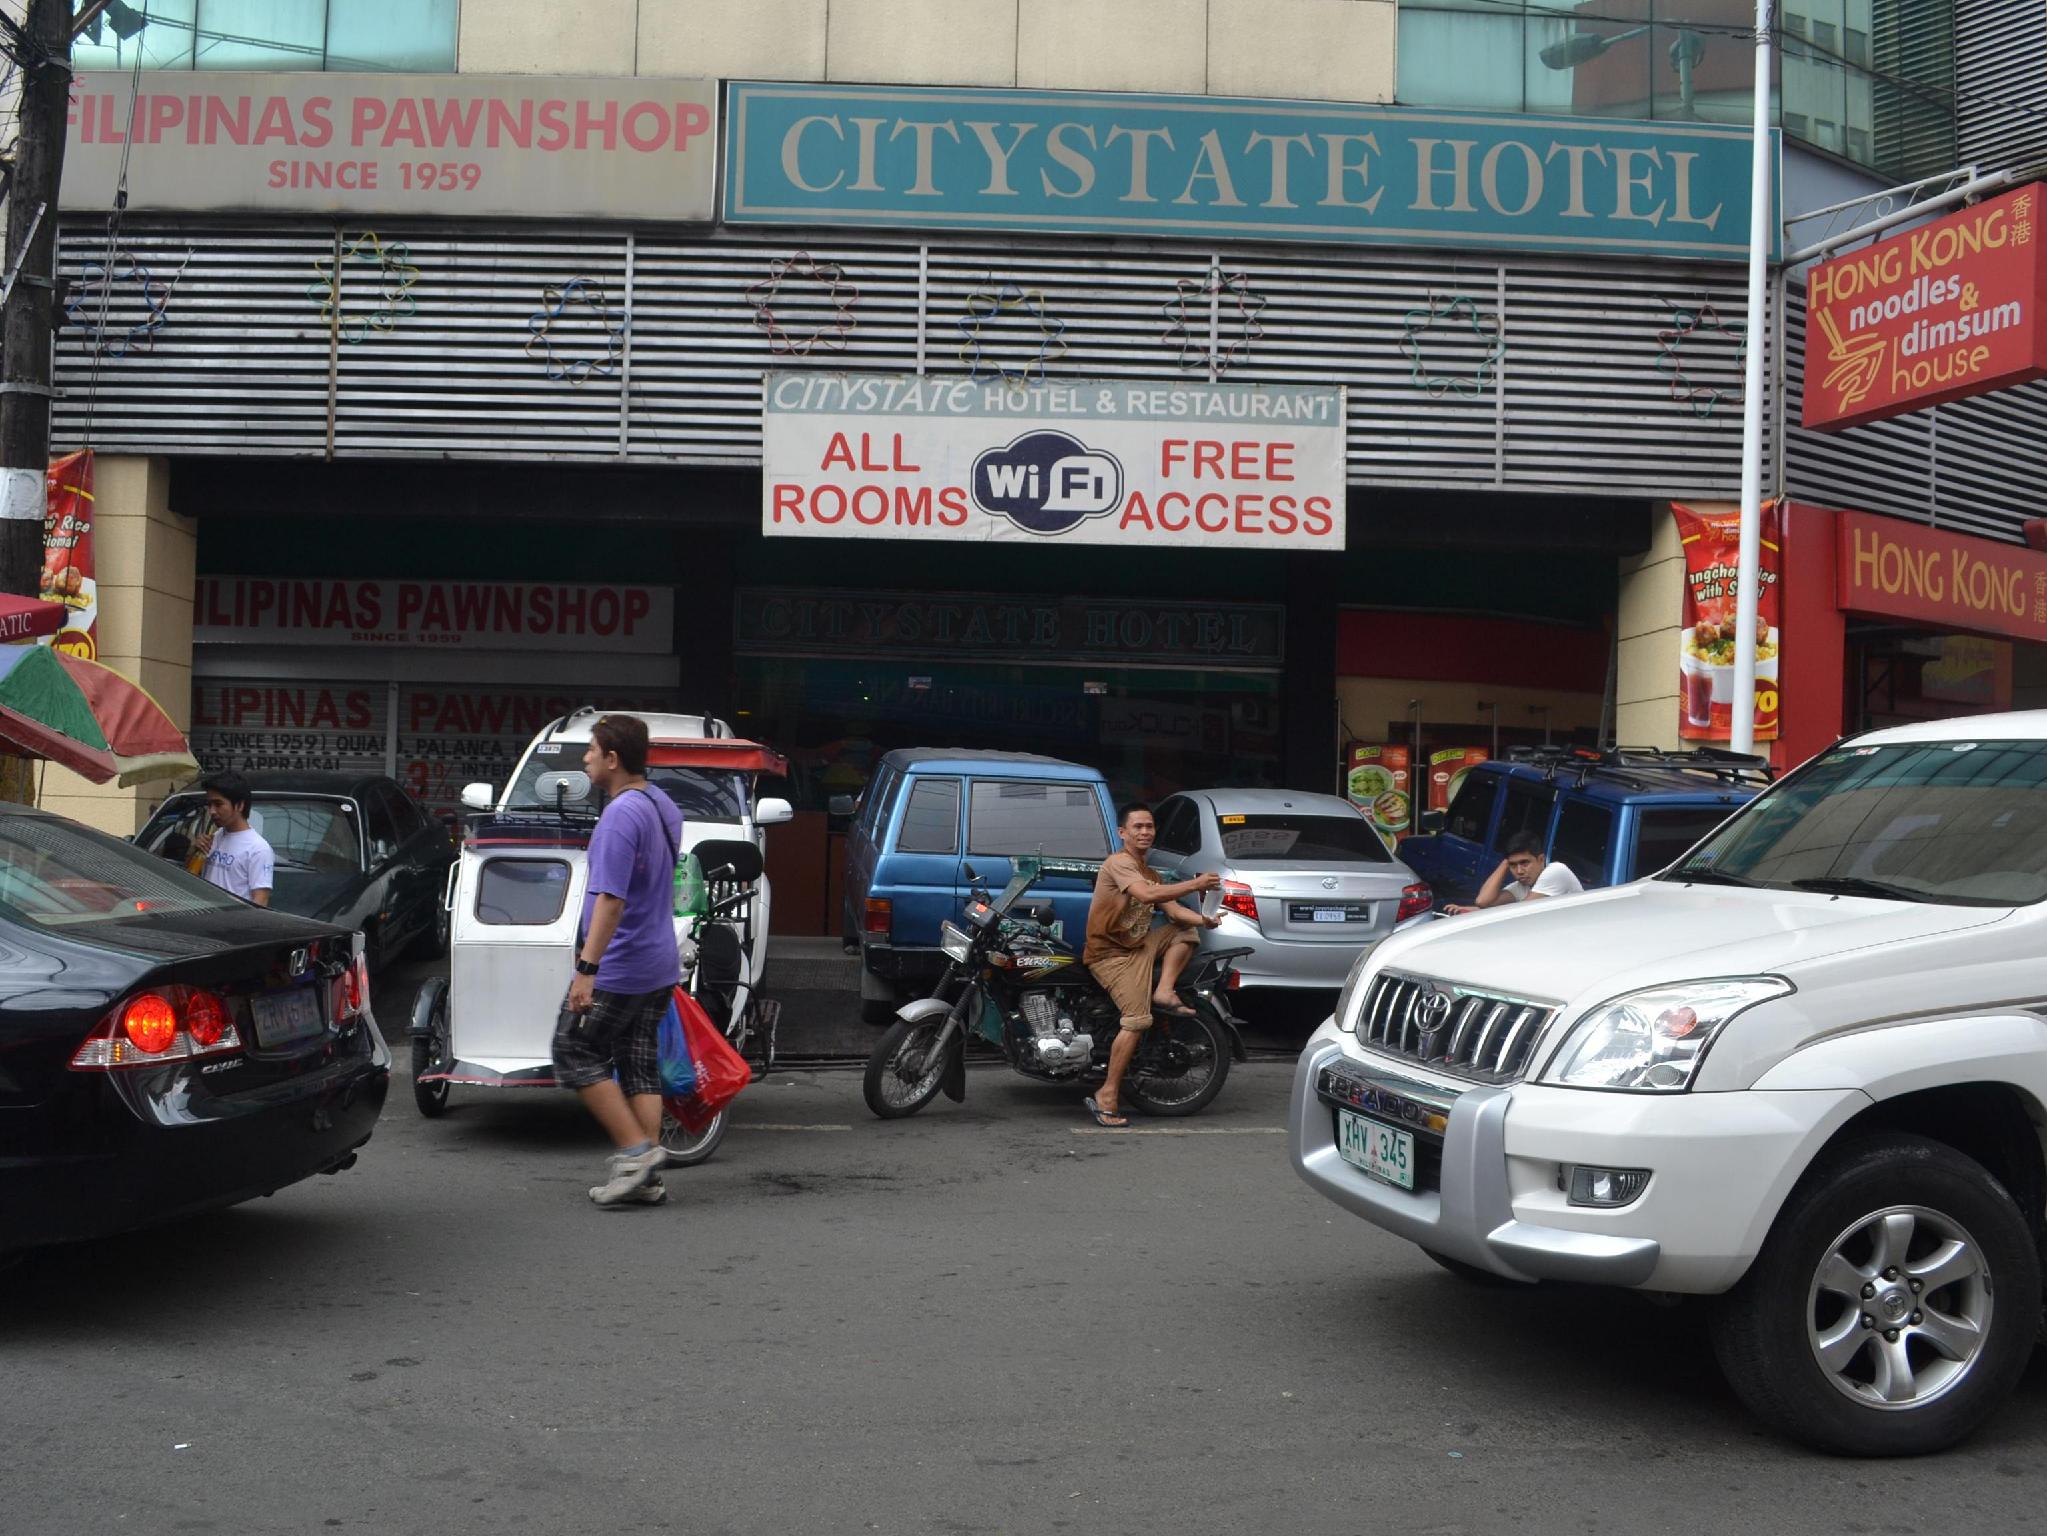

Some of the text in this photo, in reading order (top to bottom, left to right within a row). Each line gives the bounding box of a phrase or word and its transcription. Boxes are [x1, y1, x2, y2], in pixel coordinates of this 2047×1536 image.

[351, 97, 711, 152] PAWNSHOP
[268, 160, 482, 192] SINCE 1959
[781, 113, 1723, 232] CITYSTATE HOTEL
[2010, 193, 2032, 247] 香港
[1810, 208, 2008, 310] HONG KONG
[1849, 274, 1980, 331] noodles &
[1901, 300, 2021, 357] dimsum
[1891, 336, 1990, 394] house
[774, 377, 1335, 420] CITYSTATE HOTEL & RESTAURANT
[821, 431, 922, 472] ALL
[1161, 439, 1295, 481] FREE
[986, 463, 1040, 499] Wi
[61, 515, 91, 534] Rice
[773, 484, 969, 527] ROOMS
[1119, 490, 1333, 536] ACCESS
[1696, 580, 1723, 602] with
[1854, 527, 2025, 617] HONG KONG
[398, 584, 650, 637] PAWNSHOP
[762, 599, 1260, 653] CITYSTATE HOTEL
[352, 632, 462, 643] SINCE 1959
[416, 739, 504, 756] PALANCA
[1344, 1118, 1407, 1169] XHV 345
